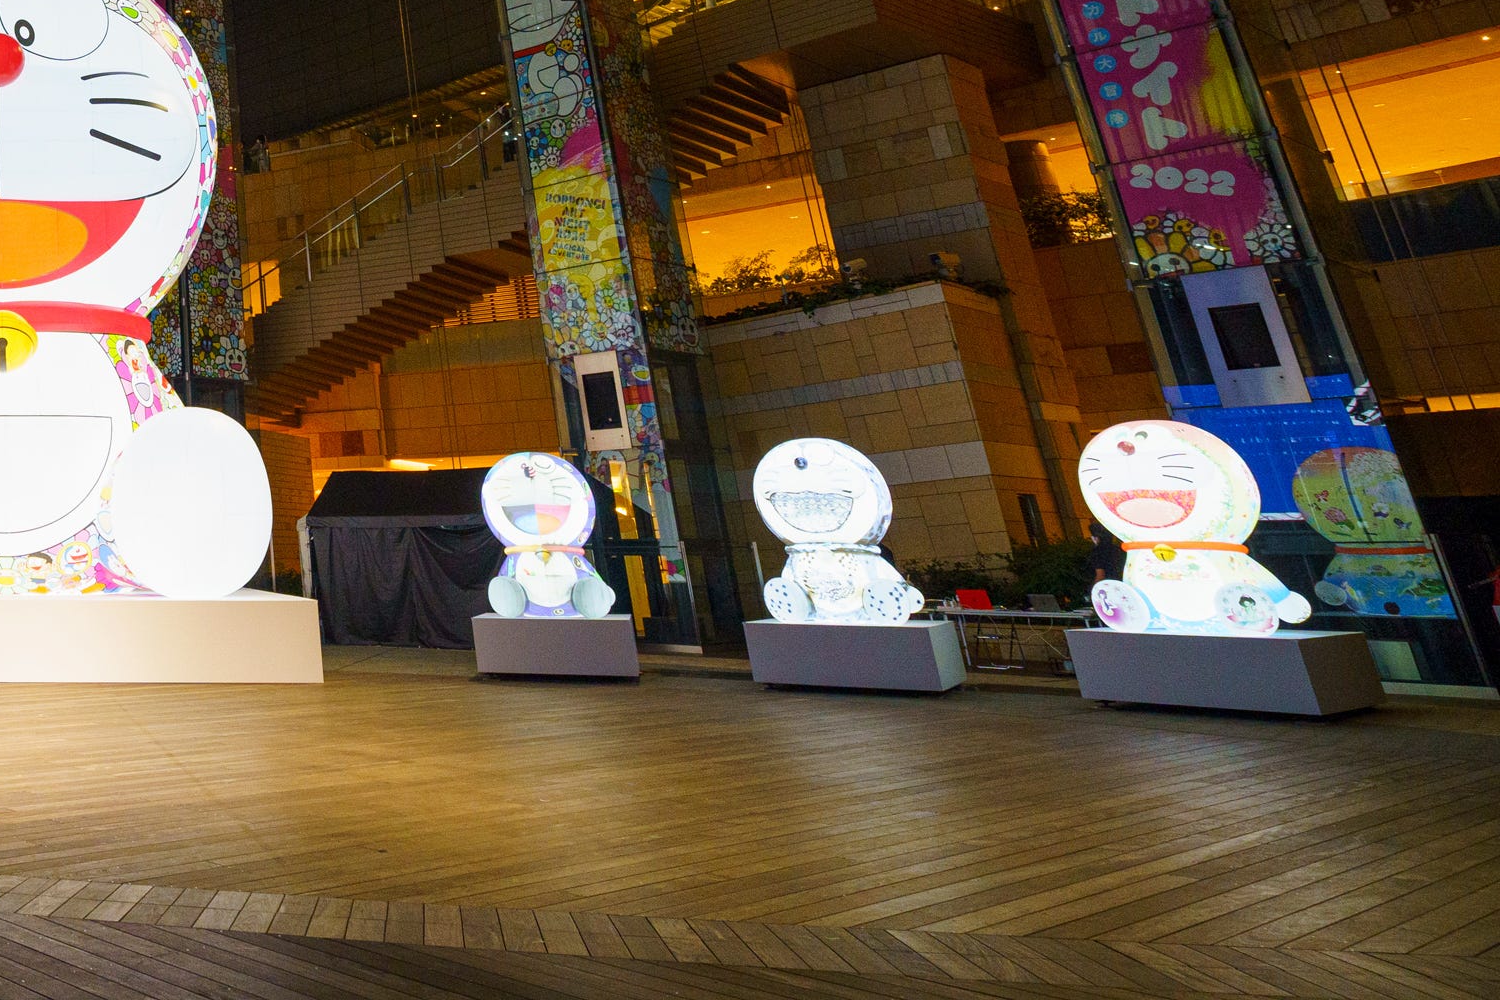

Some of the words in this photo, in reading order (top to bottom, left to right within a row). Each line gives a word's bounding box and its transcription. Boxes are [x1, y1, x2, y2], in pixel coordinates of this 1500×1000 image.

[1129, 163, 1236, 197] 2022
[545, 193, 606, 209] ROPPONGI
[562, 207, 585, 218] ART
[555, 217, 590, 230] NIGHT
